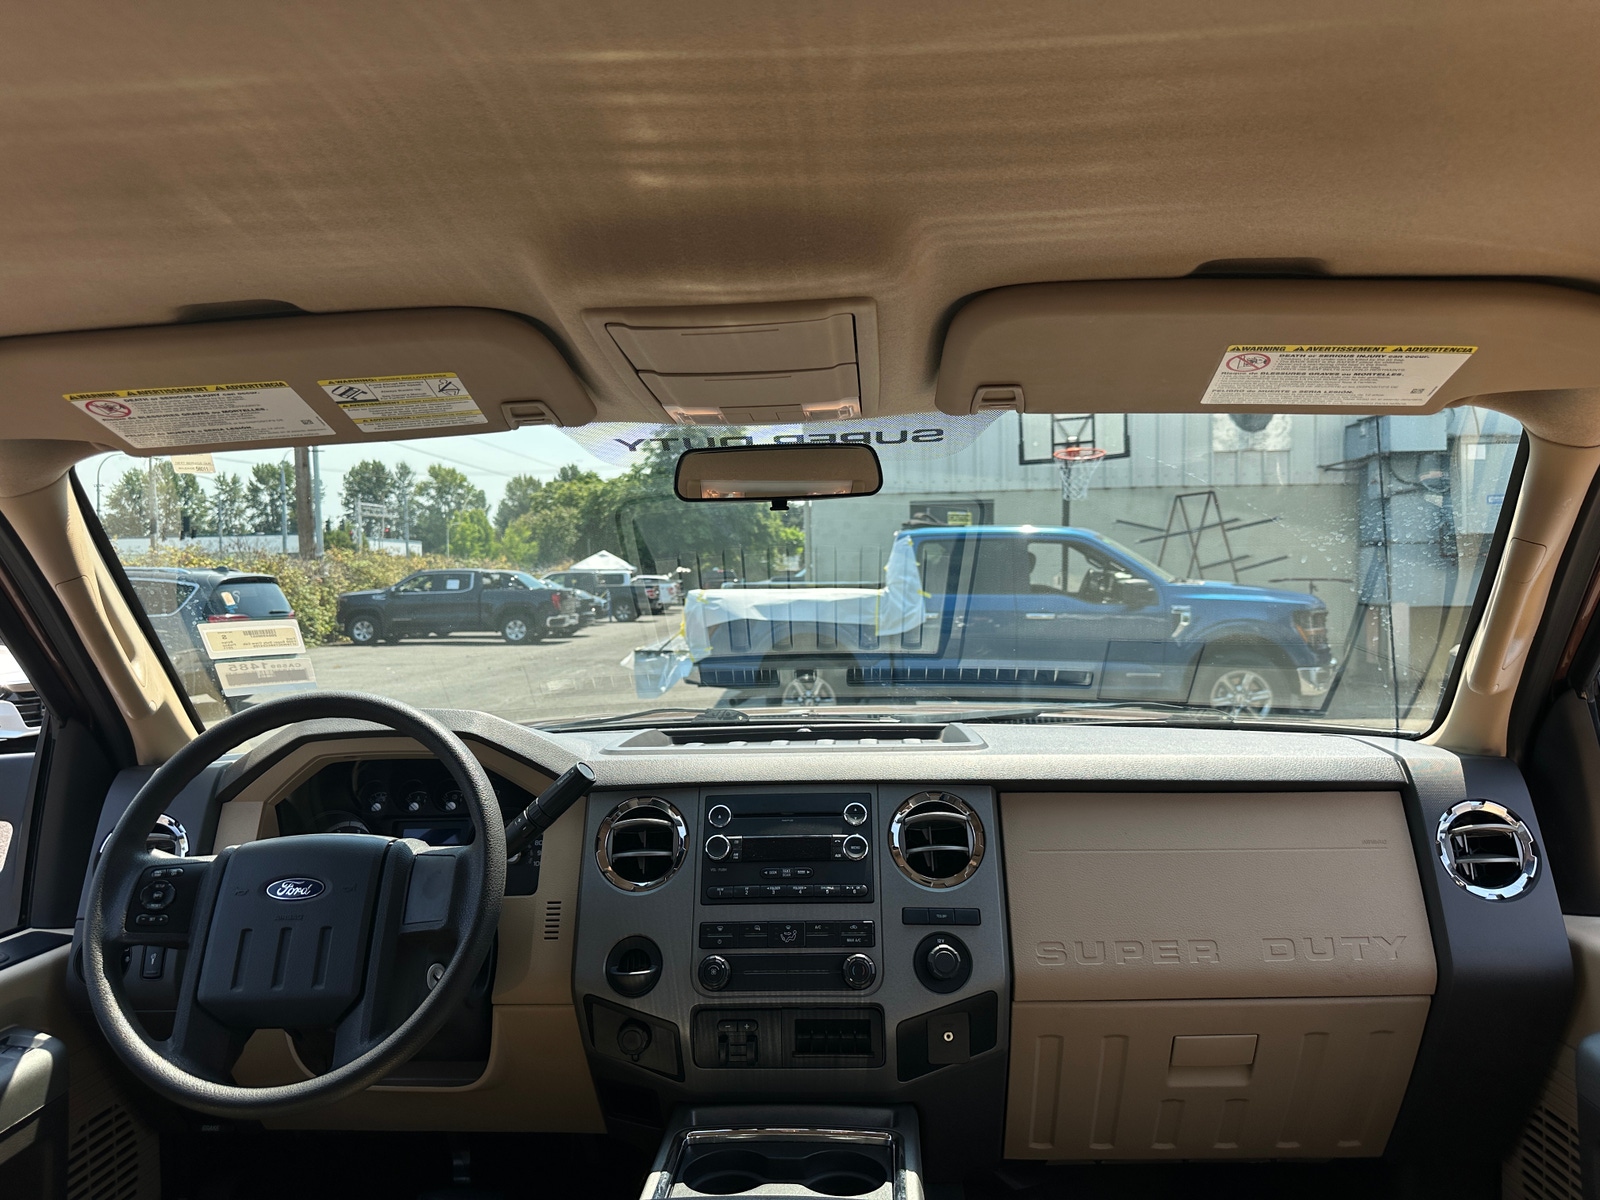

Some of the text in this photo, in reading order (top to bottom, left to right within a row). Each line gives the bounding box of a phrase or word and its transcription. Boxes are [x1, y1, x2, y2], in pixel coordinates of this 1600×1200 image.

[136, 387, 208, 396] AVERTISSEMENT
[226, 382, 286, 390] ADVERTENCIA
[276, 881, 313, 895] Ford
[1035, 935, 1407, 965] SUPER DUTY
